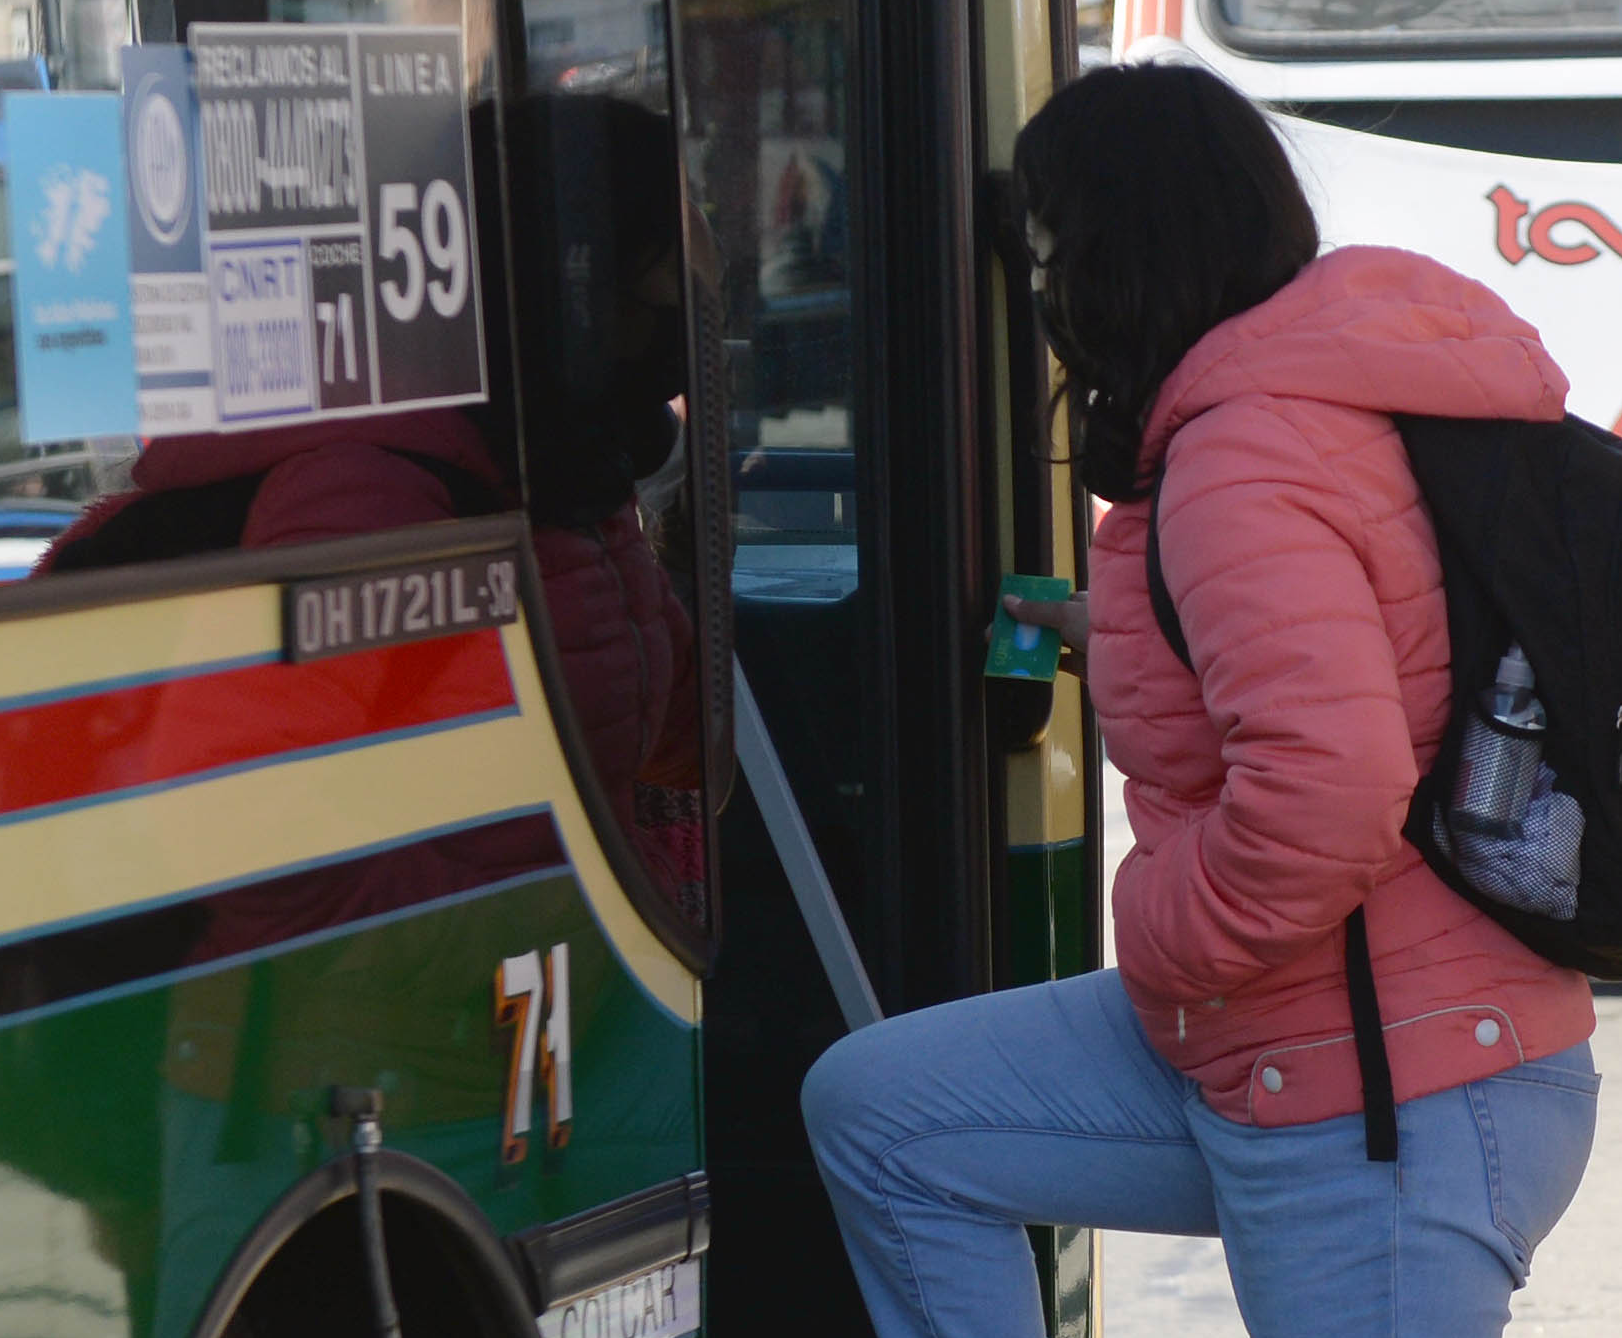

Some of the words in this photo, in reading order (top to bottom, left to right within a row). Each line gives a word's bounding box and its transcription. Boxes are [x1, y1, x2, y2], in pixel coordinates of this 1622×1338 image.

[198, 43, 317, 88] RECLAMOS
[317, 45, 349, 87] AL
[367, 52, 454, 95] LINEA
[217, 255, 299, 302] CNRT
[309, 240, 362, 267] COCHE
[379, 178, 469, 322] 59
[316, 292, 358, 385] 71
[295, 586, 353, 653] OH
[494, 942, 573, 1166] 71
